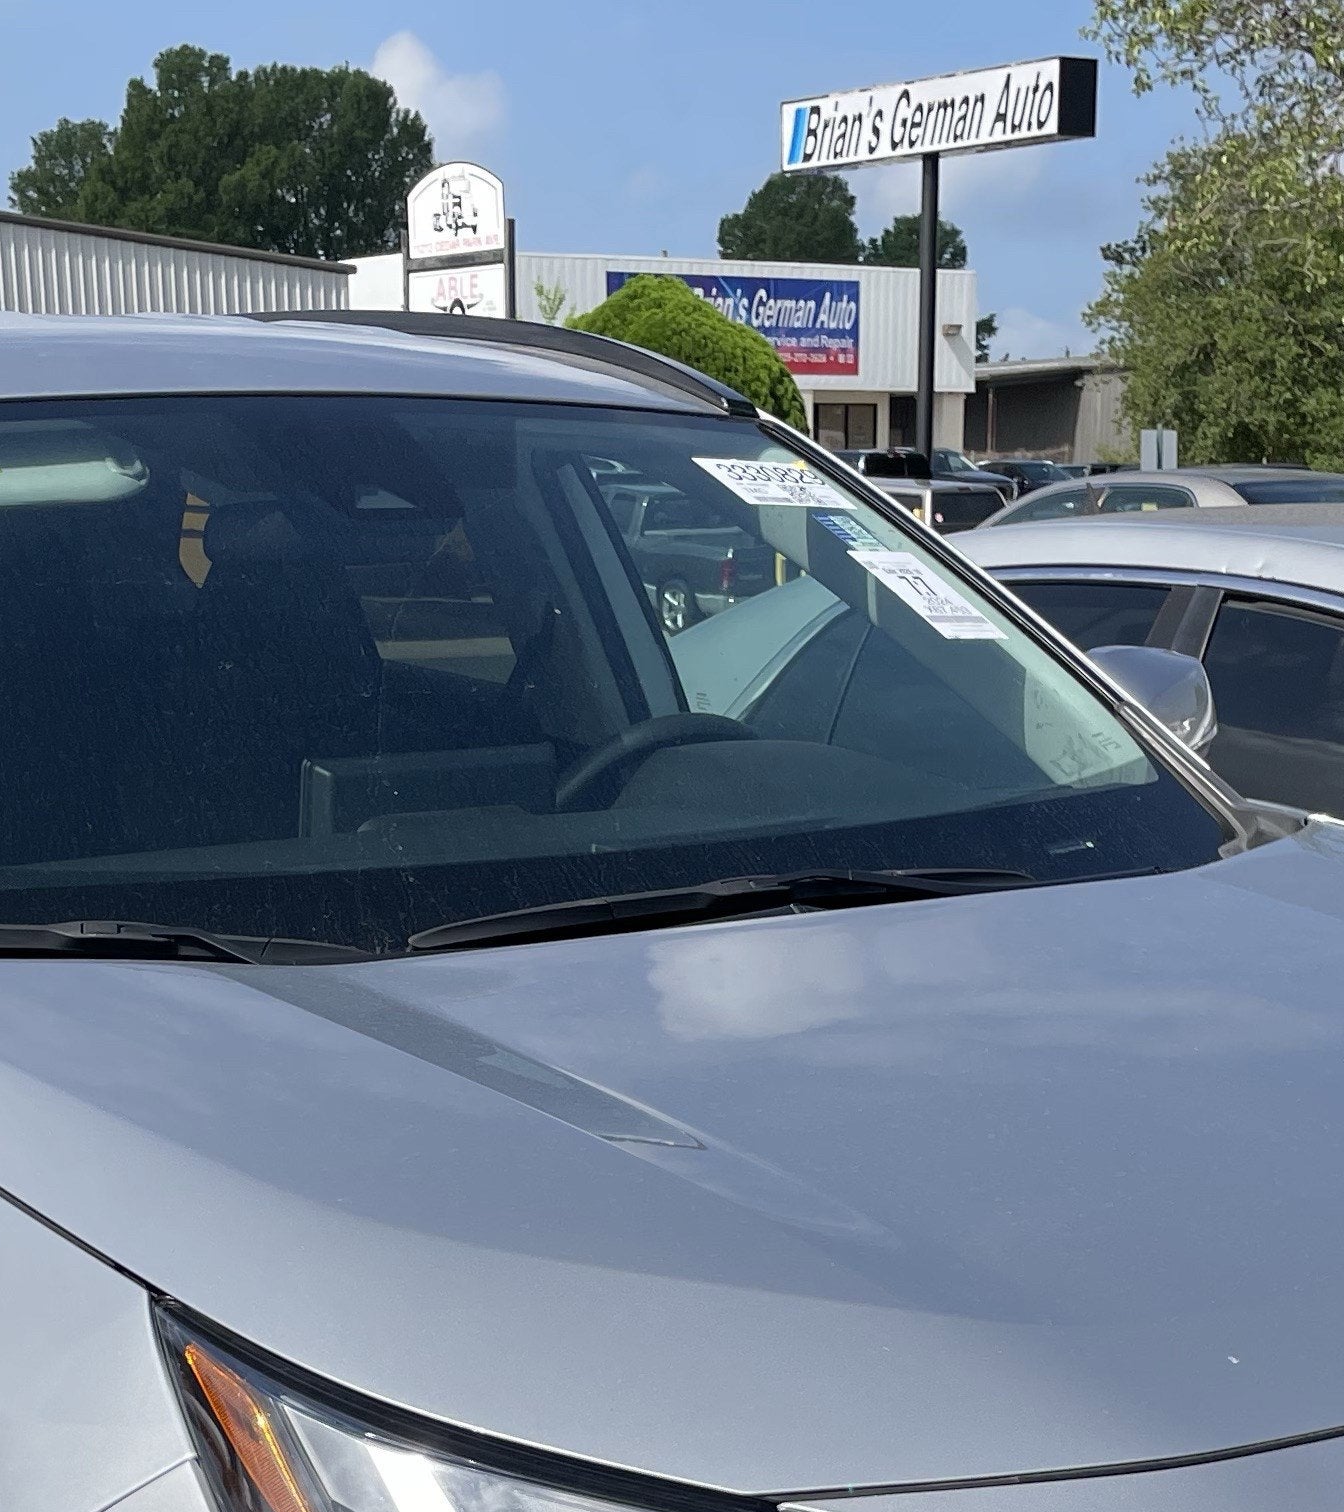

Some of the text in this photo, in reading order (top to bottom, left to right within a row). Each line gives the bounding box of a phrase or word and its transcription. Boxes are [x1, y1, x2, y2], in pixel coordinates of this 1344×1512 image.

[802, 71, 1054, 163] Brian's German Auto
[437, 272, 478, 302] ABLE
[751, 288, 816, 328] German
[816, 291, 856, 330] Auto
